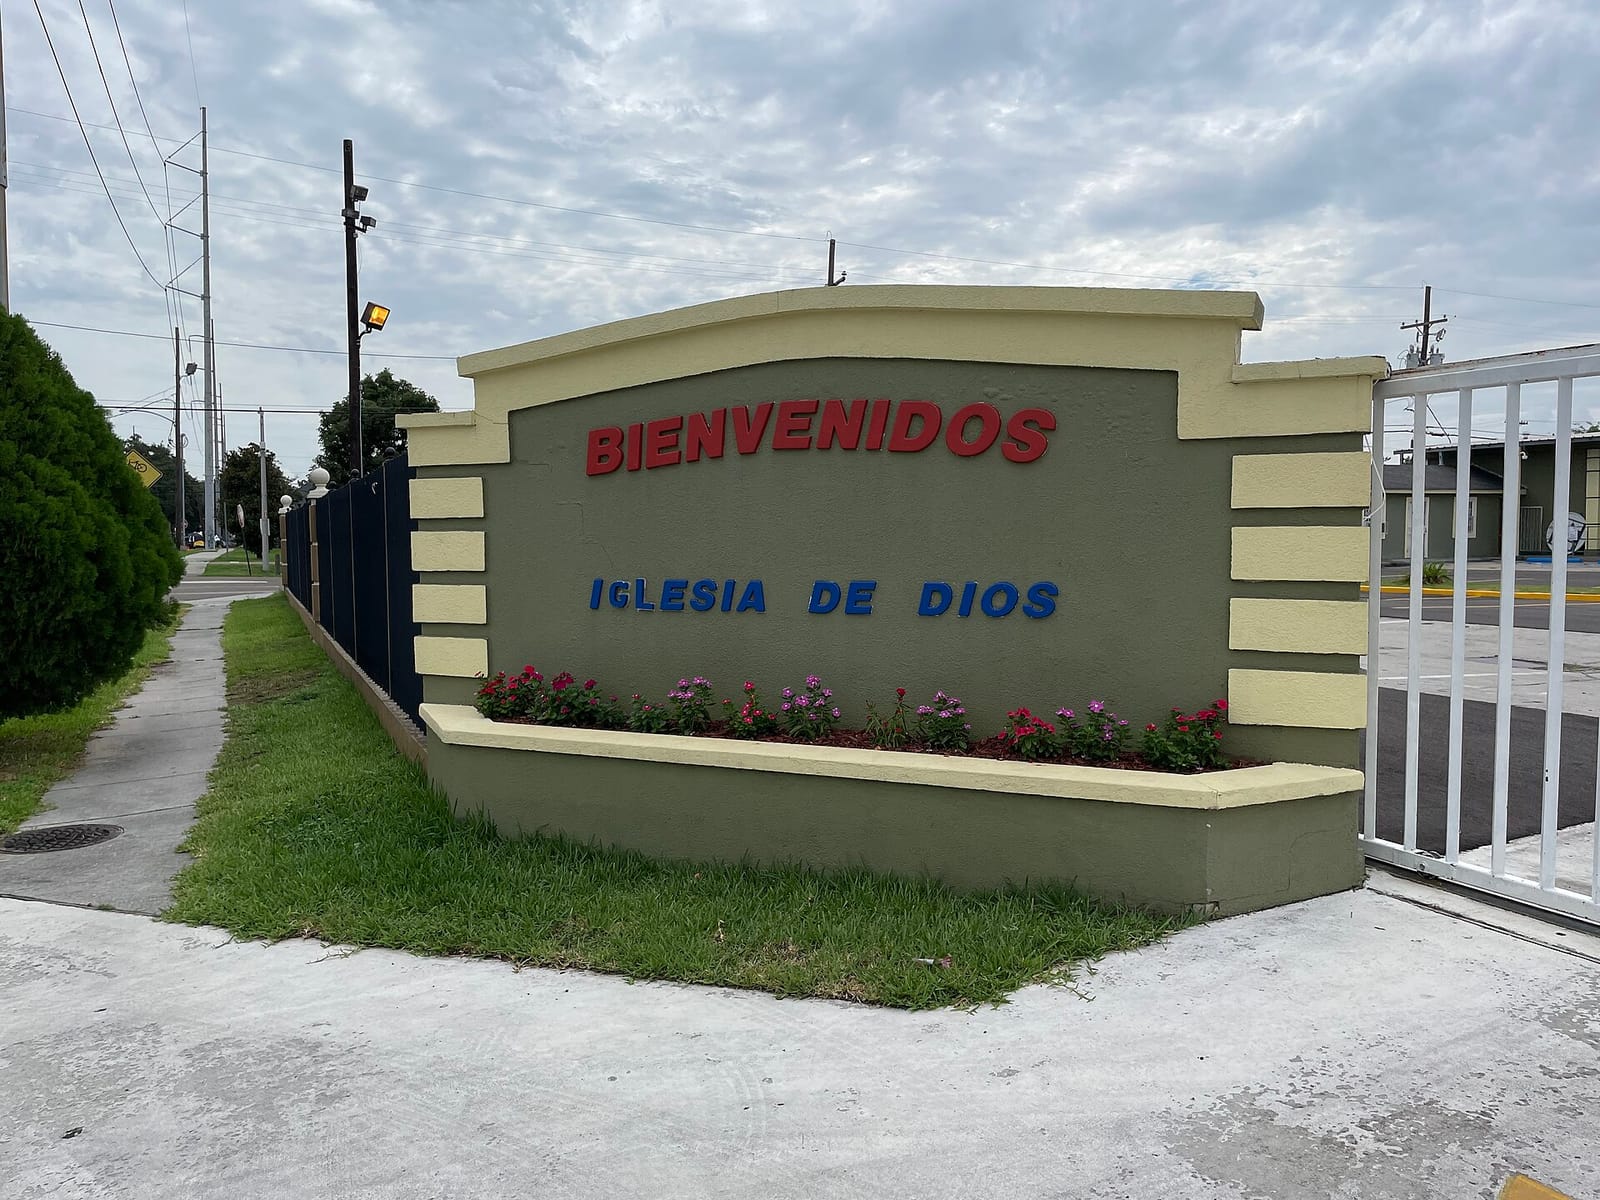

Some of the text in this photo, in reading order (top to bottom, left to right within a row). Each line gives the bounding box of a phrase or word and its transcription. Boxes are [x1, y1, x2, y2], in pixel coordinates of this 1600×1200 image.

[585, 398, 1057, 476] BIENVENIDOS
[589, 577, 1060, 619] IGLESIA DE DIOS
